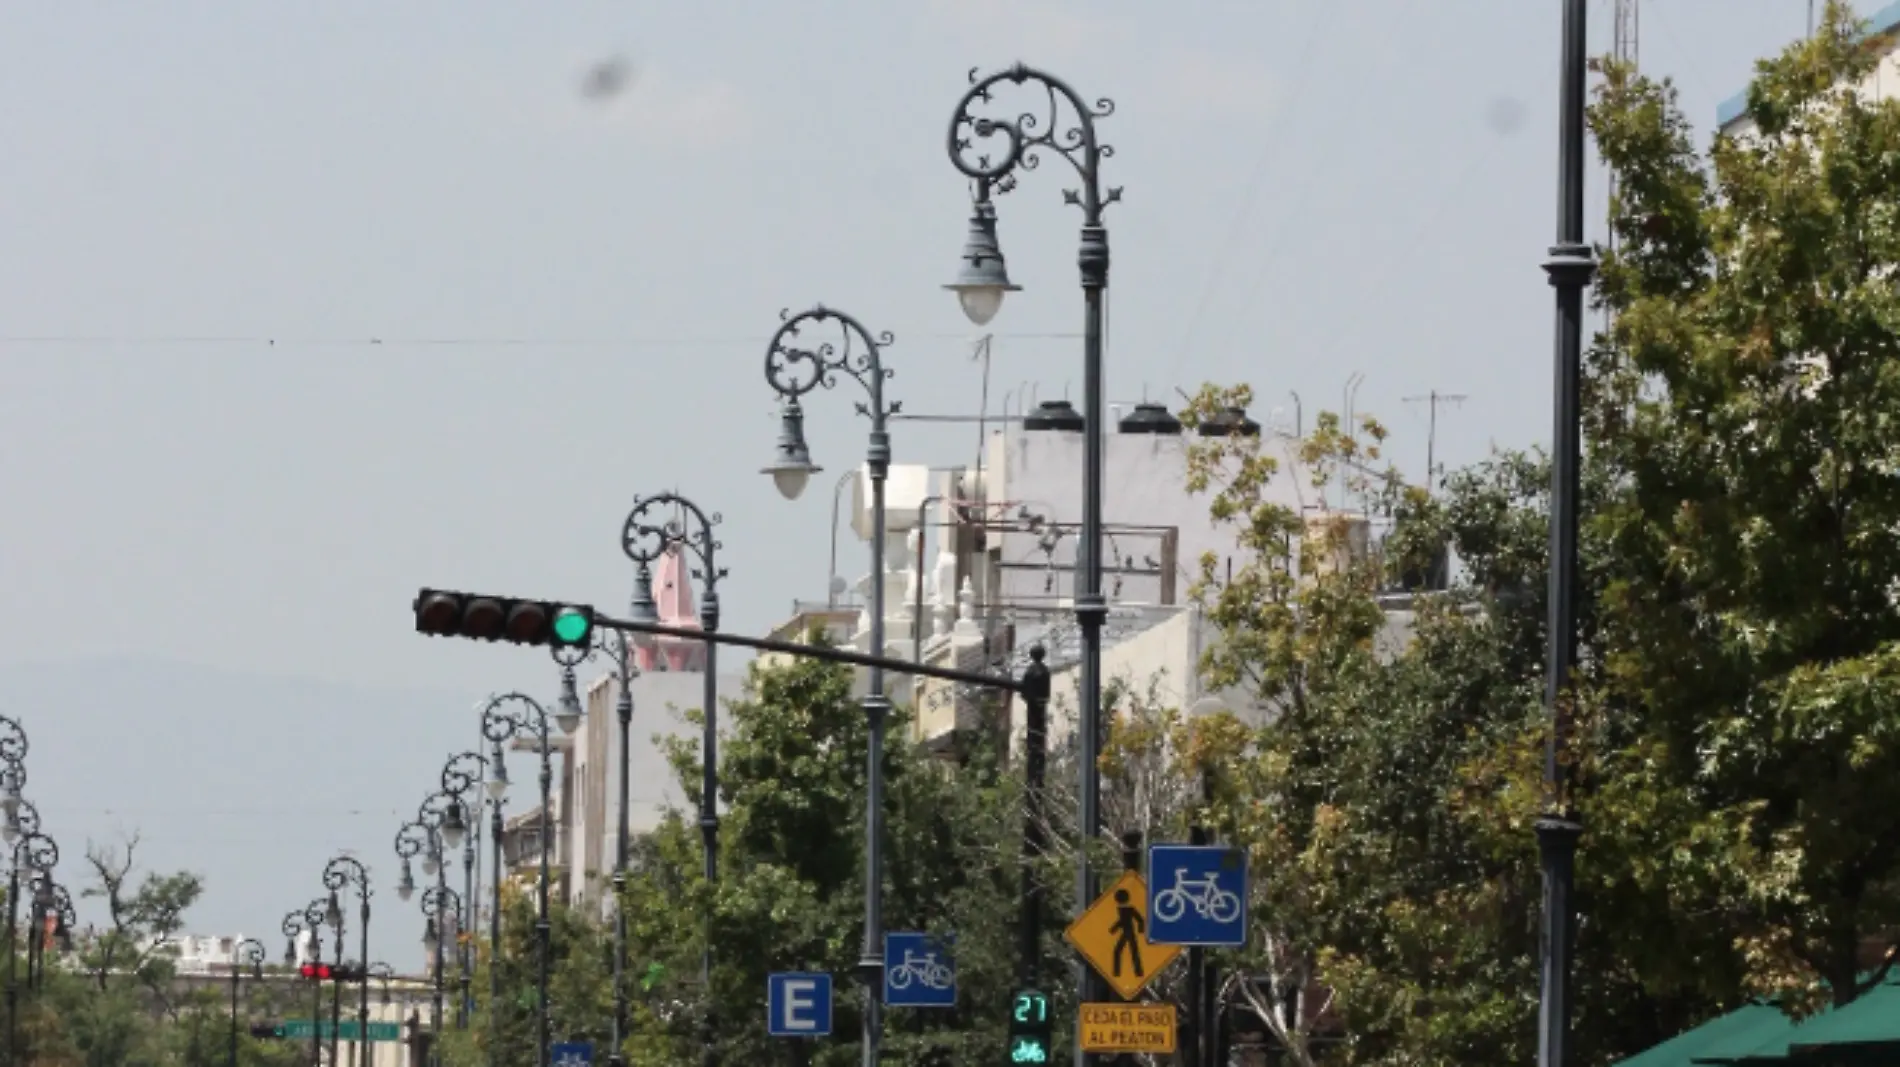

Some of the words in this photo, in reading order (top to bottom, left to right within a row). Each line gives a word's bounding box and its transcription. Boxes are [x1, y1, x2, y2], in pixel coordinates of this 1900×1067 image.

[785, 981, 815, 1029] E
[1015, 996, 1045, 1021] 27
[1138, 1010, 1171, 1026] PASO
[1088, 1031, 1105, 1045] AL
